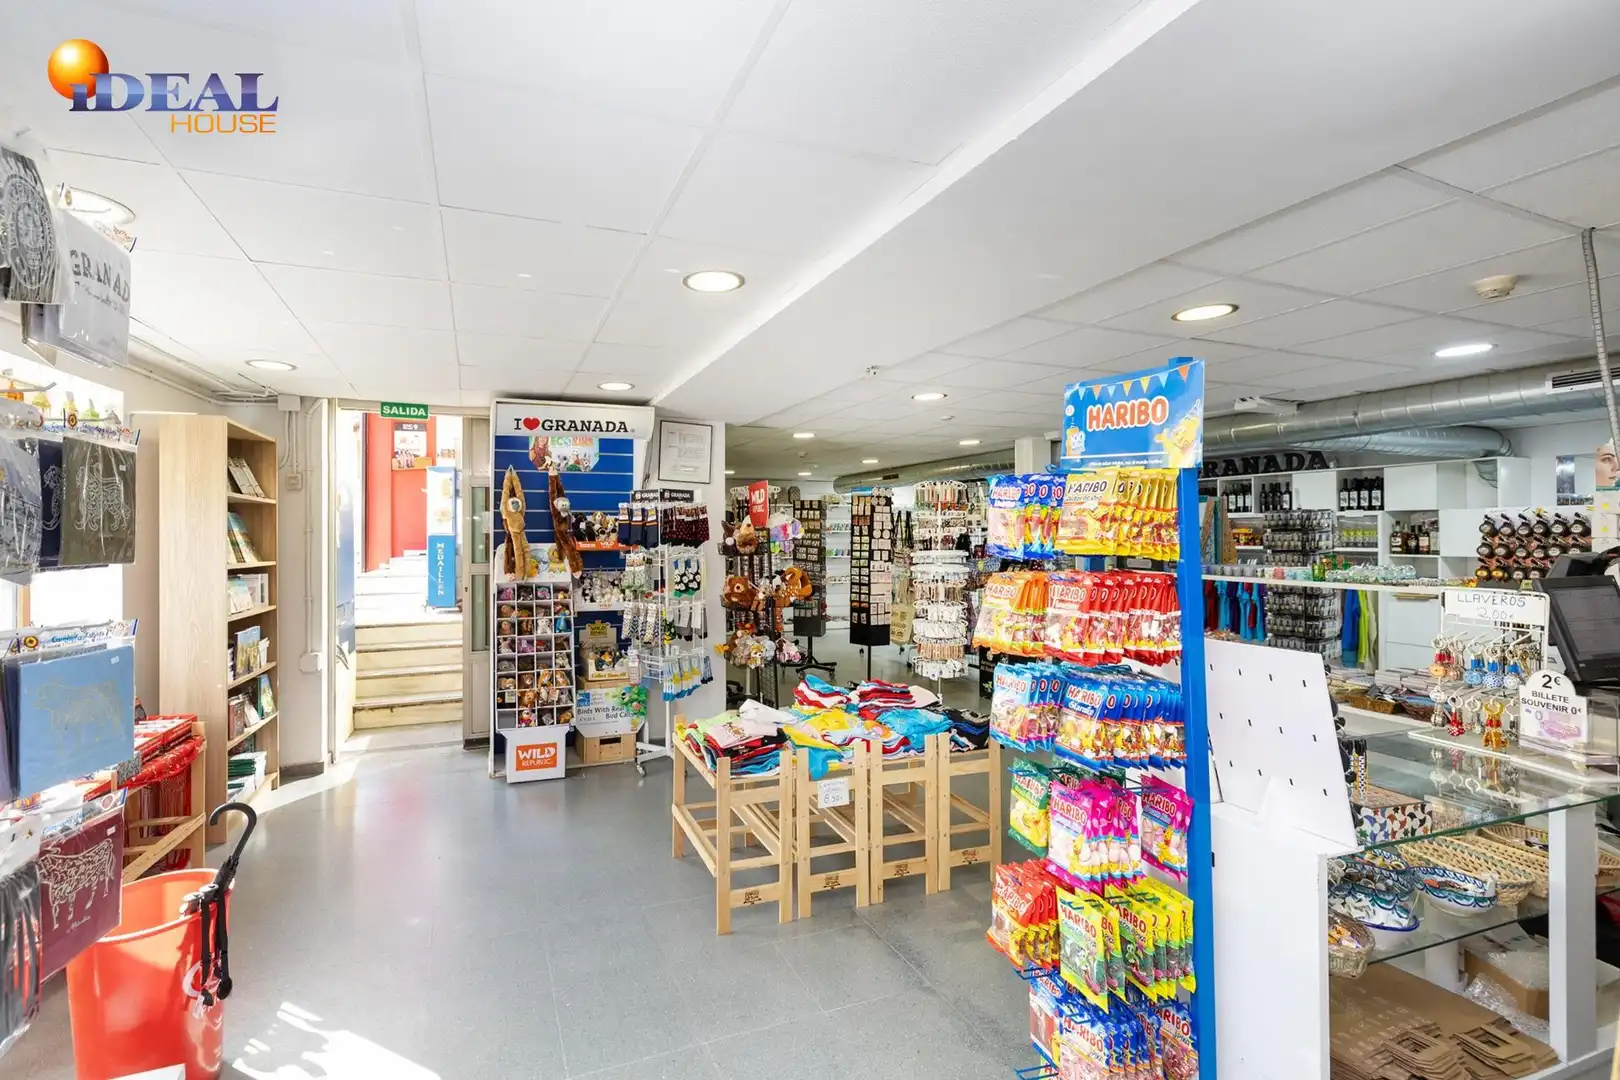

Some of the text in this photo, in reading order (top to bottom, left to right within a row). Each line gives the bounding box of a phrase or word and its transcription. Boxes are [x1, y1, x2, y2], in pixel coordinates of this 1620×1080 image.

[382, 405, 426, 416] SALIDA
[1087, 396, 1169, 431] HARIBO
[541, 419, 628, 433] GRANADA
[1198, 451, 1330, 478] RANADA
[1067, 480, 1108, 494] HARIBO
[986, 585, 1017, 599] HARIBO
[1457, 593, 1526, 608] LLAVEROS
[995, 674, 1027, 693] HARIBO
[1067, 684, 1102, 708] HARIBO
[1531, 690, 1570, 703] BILLETE
[577, 708, 593, 716] Birds
[1521, 697, 1569, 714] SOUVENIR
[605, 712, 618, 720] Bird
[518, 746, 556, 760] WILD
[1053, 796, 1088, 826] HARIBO
[1142, 792, 1177, 817] HARIBO
[995, 881, 1027, 913] HARIBO
[1060, 904, 1097, 939] HARIBO
